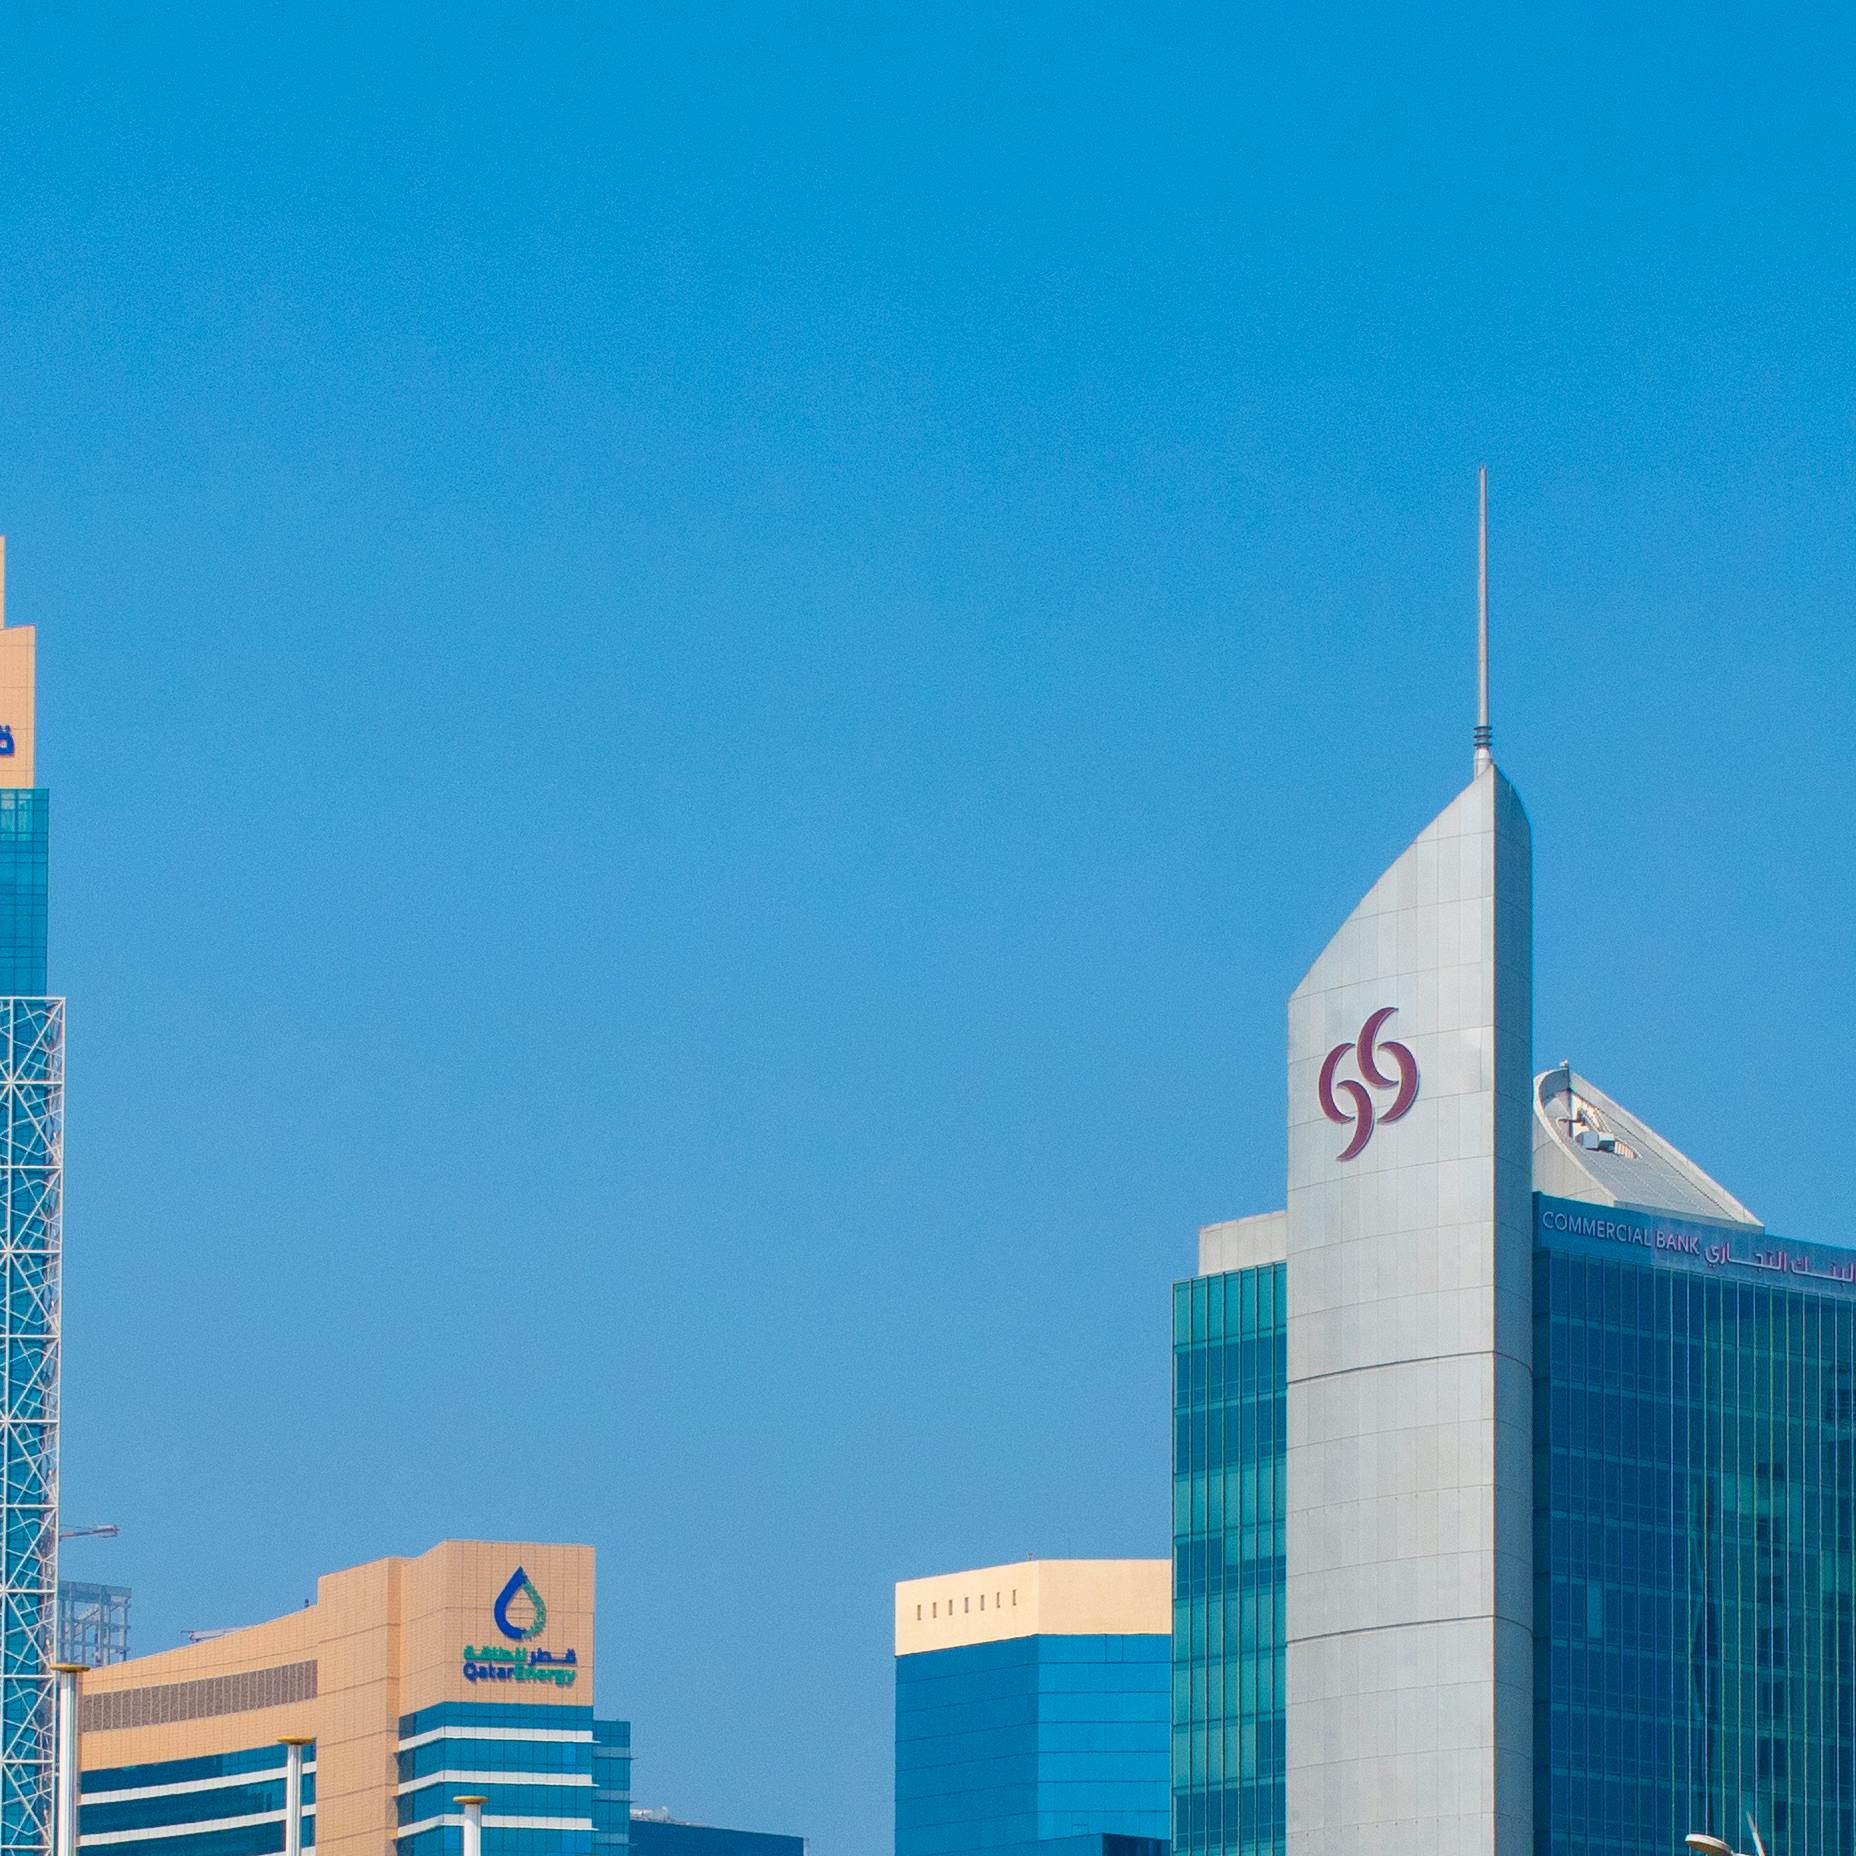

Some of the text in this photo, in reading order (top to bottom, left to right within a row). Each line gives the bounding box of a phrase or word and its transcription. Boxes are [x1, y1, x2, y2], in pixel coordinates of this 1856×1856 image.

[1542, 1211, 1700, 1255] COMMERCIAL BANK
[1704, 1243, 1788, 1274] التجاري
